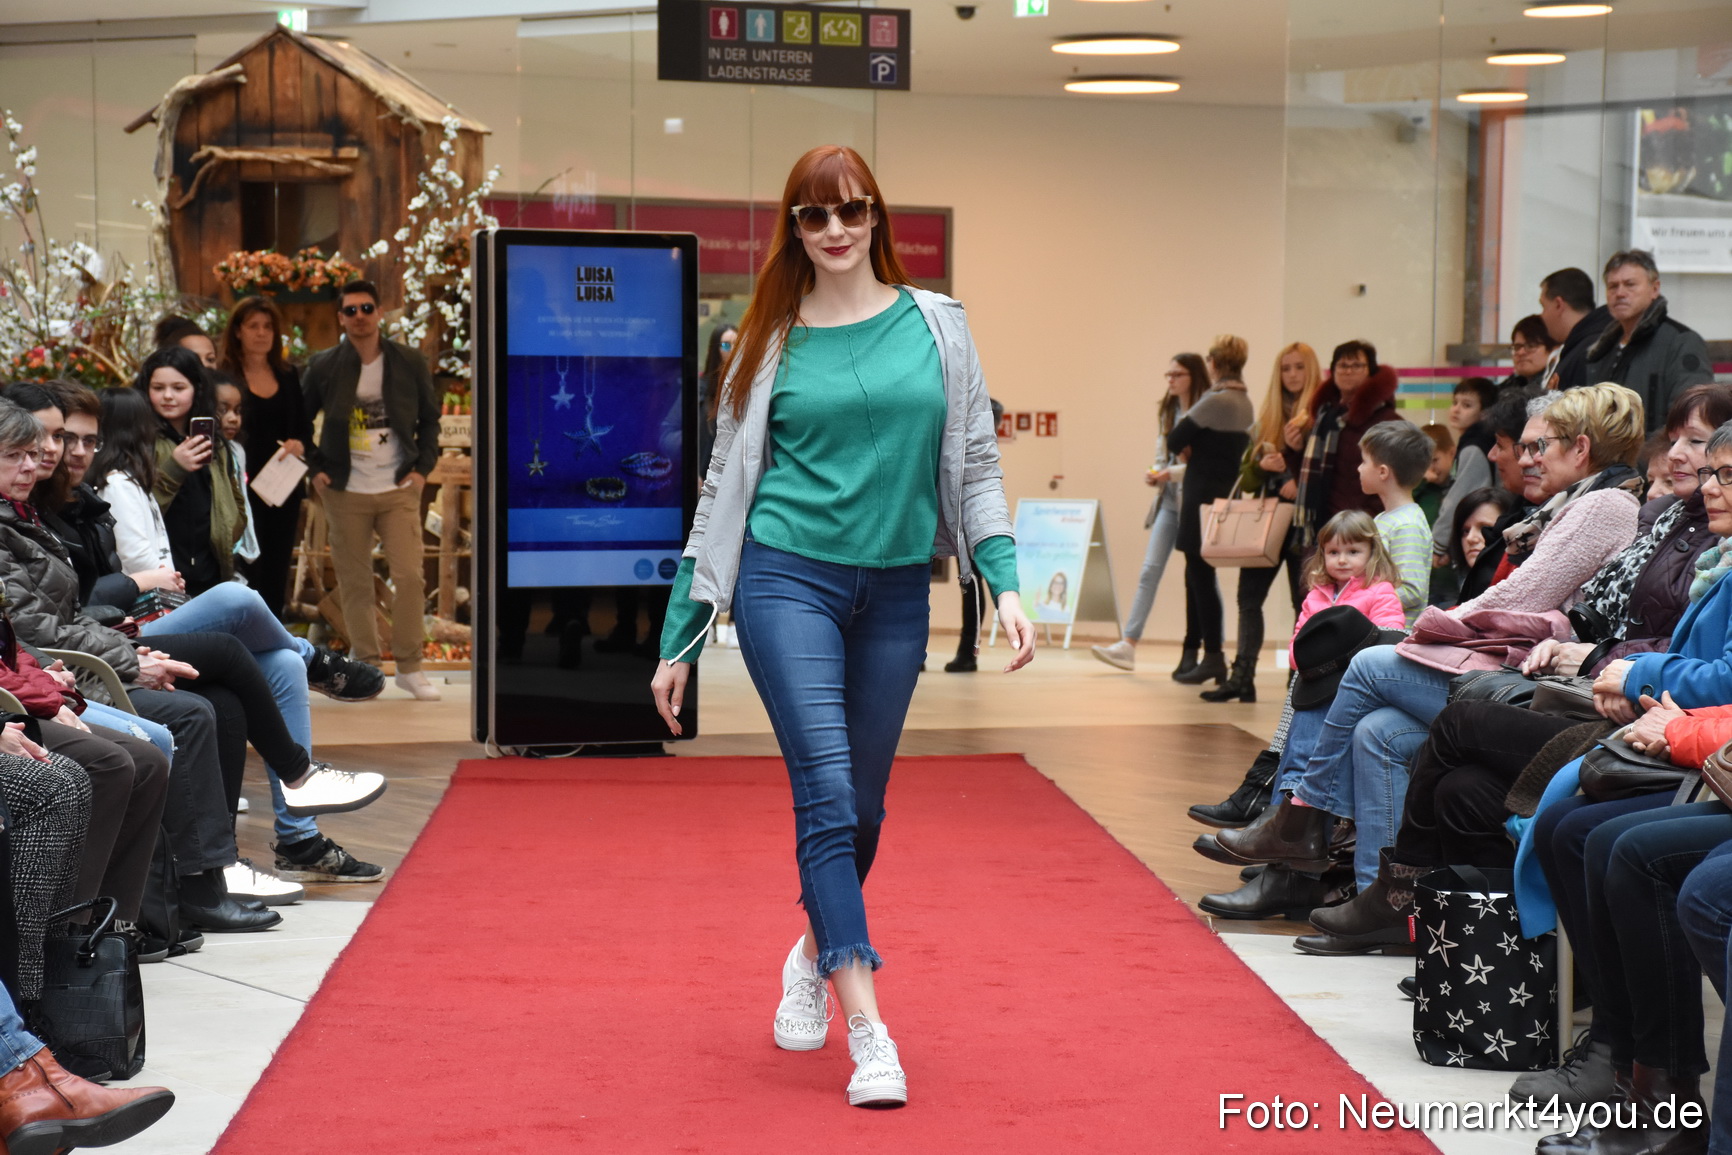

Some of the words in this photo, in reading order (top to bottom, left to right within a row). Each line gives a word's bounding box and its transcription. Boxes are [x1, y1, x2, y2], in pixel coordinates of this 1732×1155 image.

[708, 47, 720, 60] IN
[724, 48, 747, 61] DER
[752, 49, 813, 64] UNTEREN
[708, 65, 813, 82] LADENSTRASSE
[1651, 226, 1668, 238] Wir
[1671, 225, 1706, 238] freuen
[1708, 228, 1726, 238] uns
[576, 266, 614, 282] LUISA
[576, 286, 614, 302] LUISA
